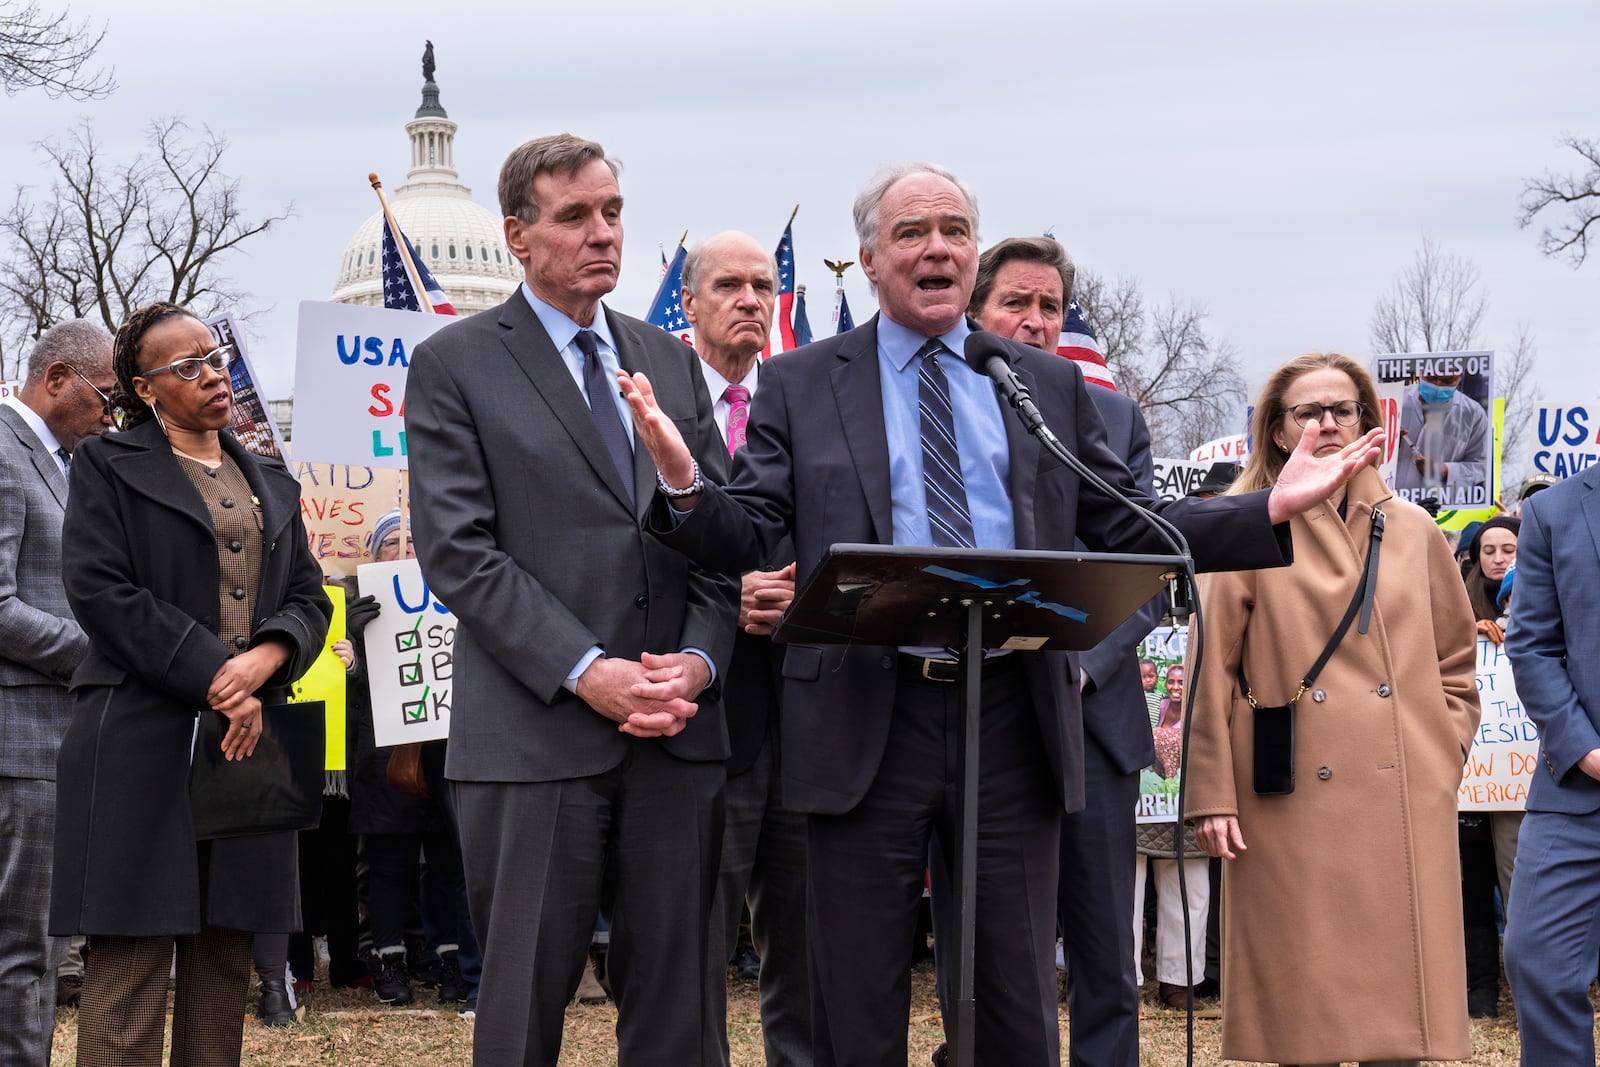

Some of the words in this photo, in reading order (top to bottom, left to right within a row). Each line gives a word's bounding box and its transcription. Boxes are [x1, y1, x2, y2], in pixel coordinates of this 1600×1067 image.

[1379, 359, 1411, 379] THE
[1415, 357, 1463, 377] FACES
[1467, 356, 1490, 375] OF
[1197, 437, 1248, 462] LIVE
[1455, 485, 1485, 505] AID
[1491, 701, 1528, 718] TH
[1473, 721, 1539, 746] ESID
